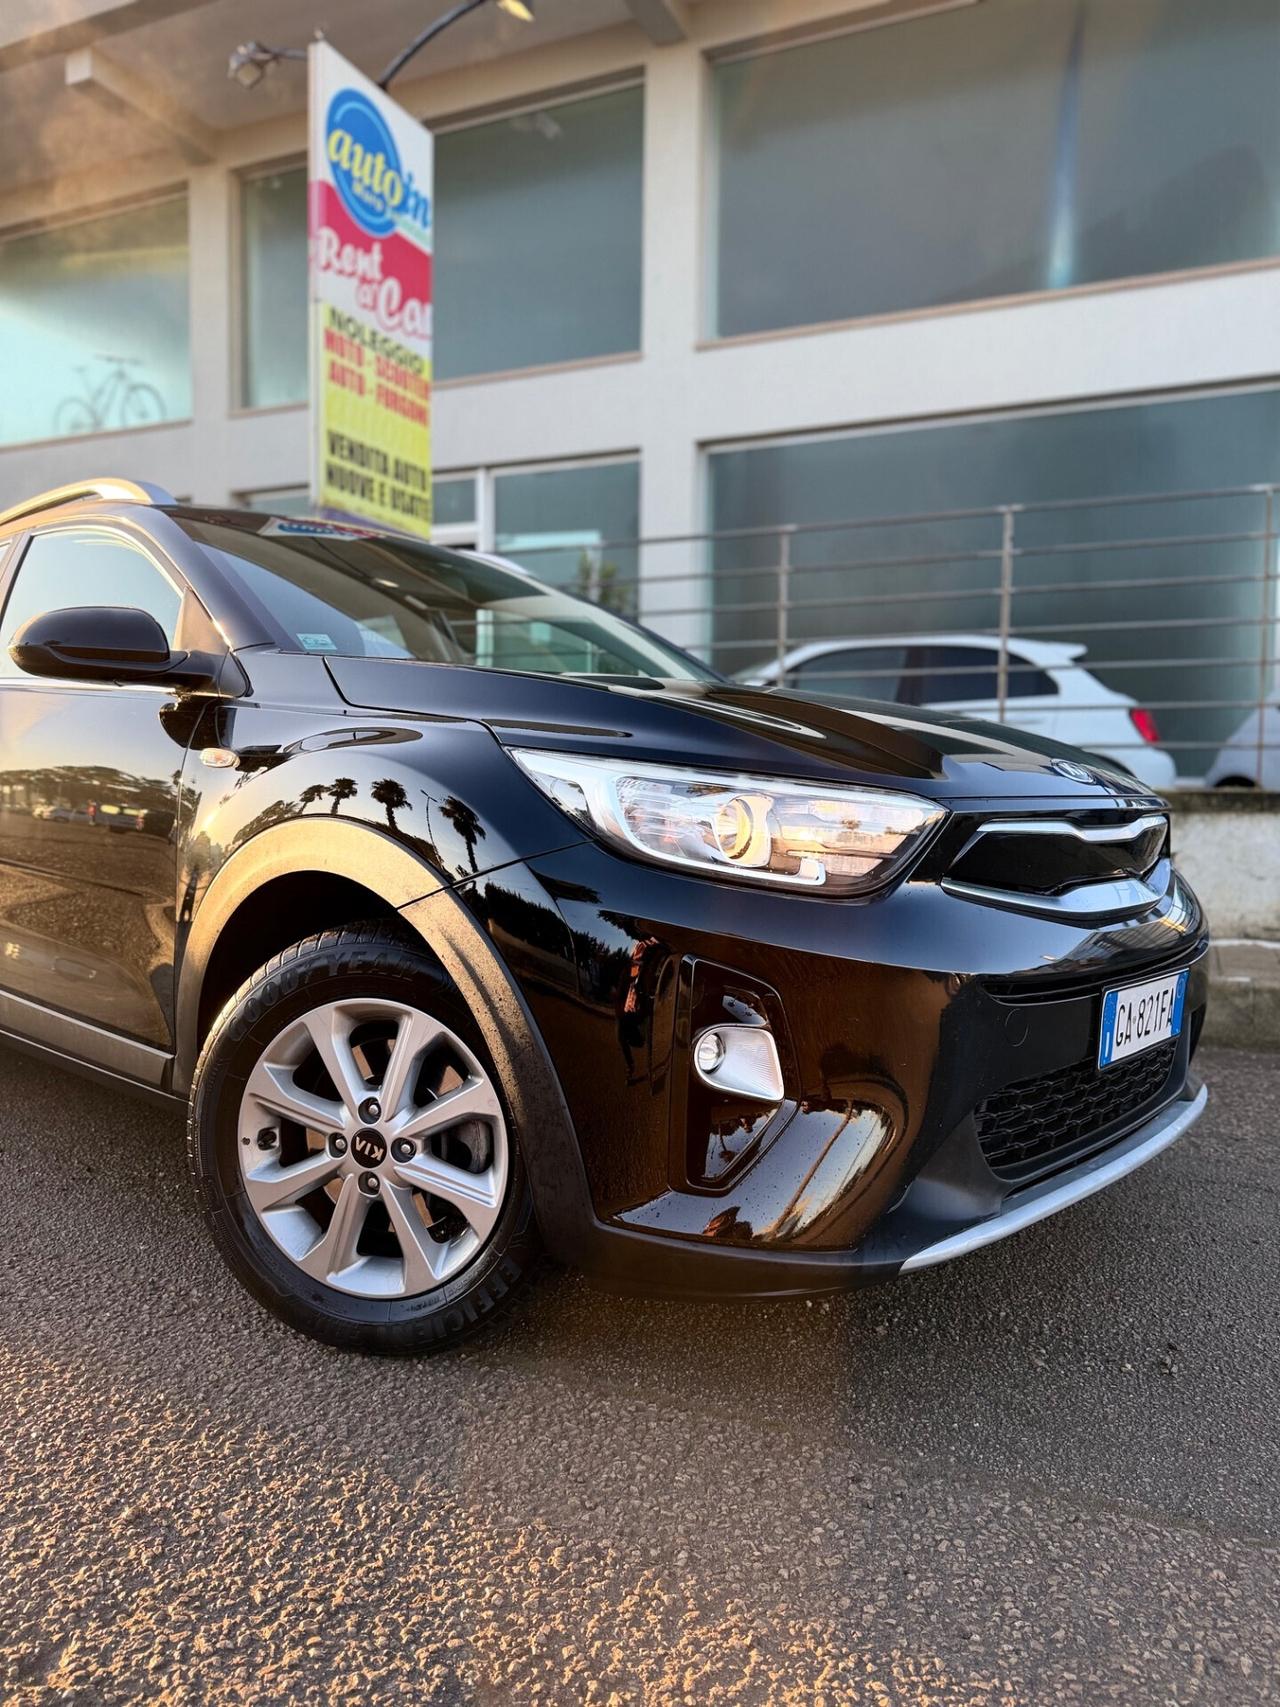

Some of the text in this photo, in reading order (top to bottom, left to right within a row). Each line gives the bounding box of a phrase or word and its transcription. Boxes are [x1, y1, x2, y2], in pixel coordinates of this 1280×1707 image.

[328, 128, 403, 208] auto
[316, 226, 383, 281] Rent
[324, 326, 364, 368] MOTO
[329, 304, 423, 375] NOLEGGIO
[328, 359, 365, 397] AUTO
[326, 460, 374, 503] NUOVE
[379, 481, 386, 508] E
[327, 429, 427, 493] VENDITA AUTO
[355, 1136, 385, 1161] KIA
